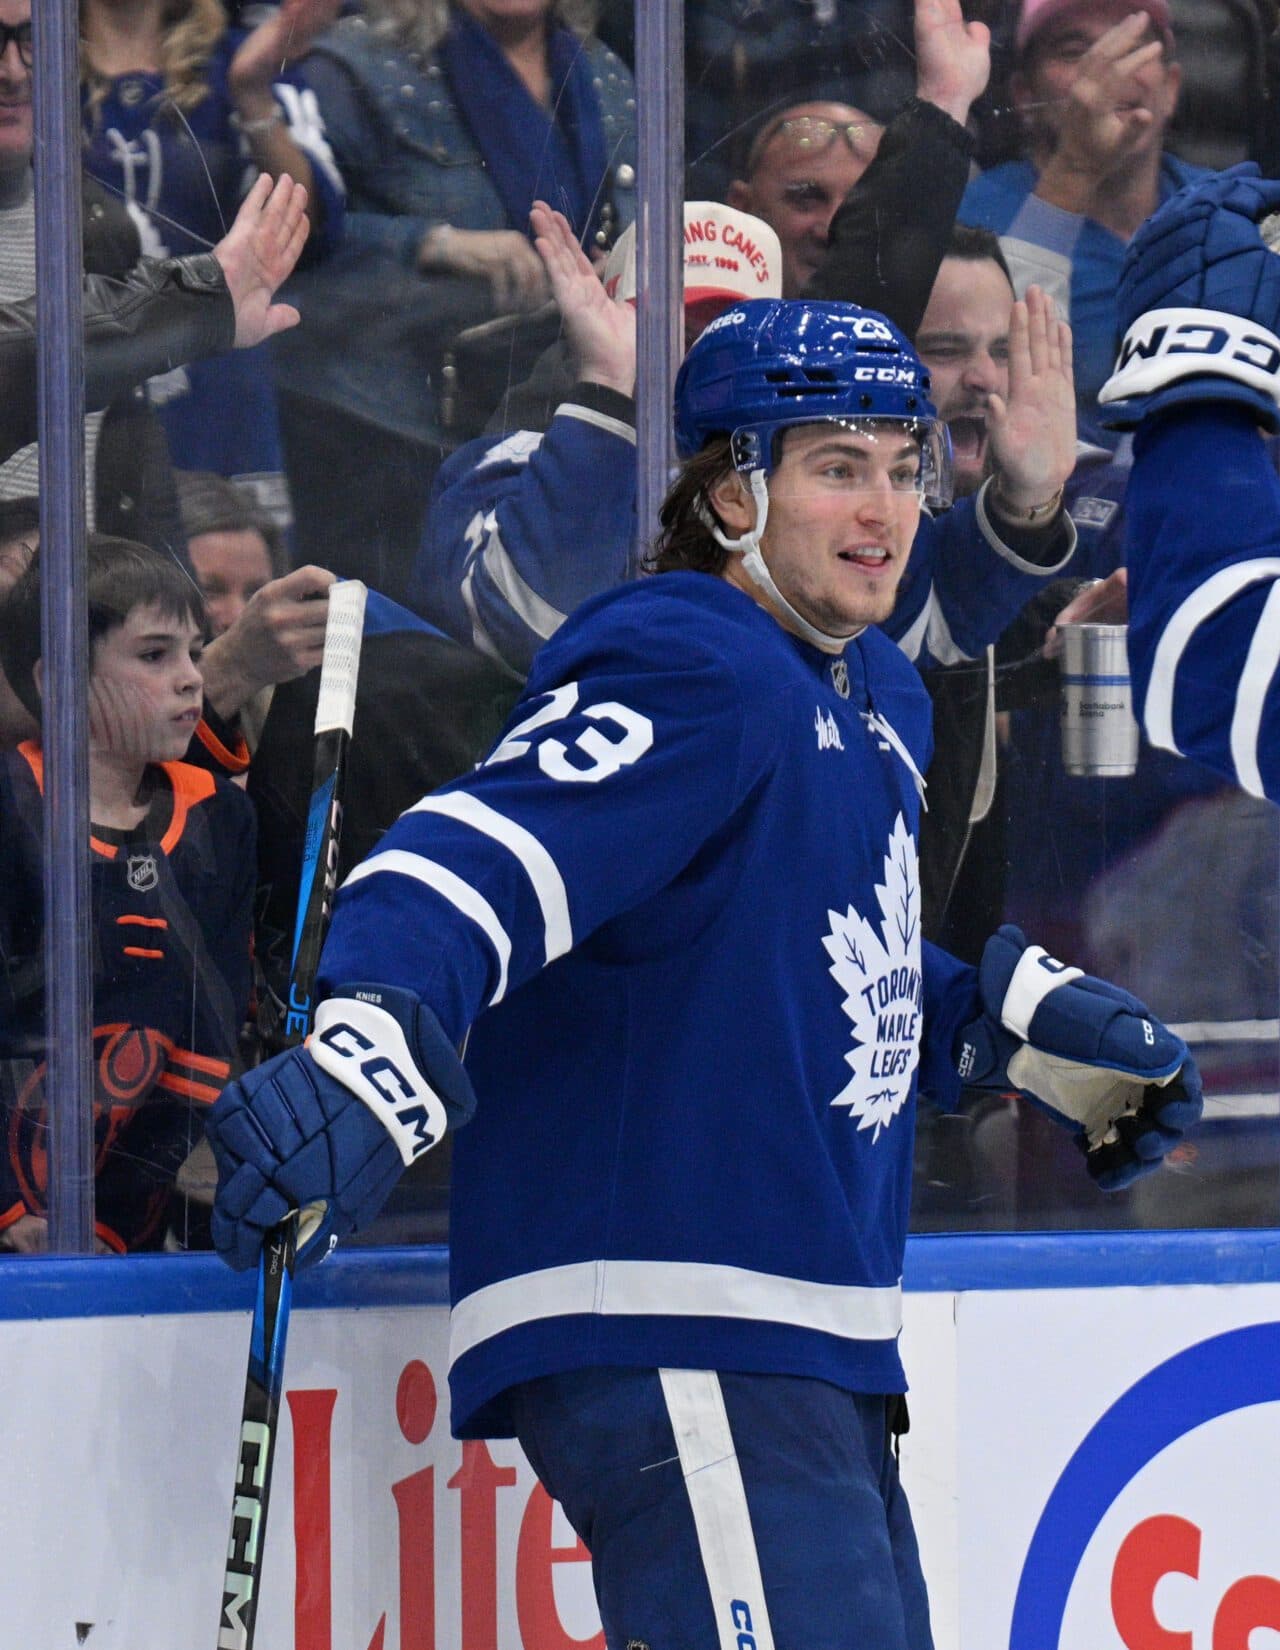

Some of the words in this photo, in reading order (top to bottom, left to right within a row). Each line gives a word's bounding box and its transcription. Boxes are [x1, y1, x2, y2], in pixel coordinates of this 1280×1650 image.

[721, 224, 770, 284] CANE'S
[854, 366, 916, 384] CCM
[355, 991, 382, 1004] KNIES
[876, 1013, 918, 1043] MAPLE
[319, 1022, 436, 1157] CCM
[217, 1419, 271, 1650] CCM
